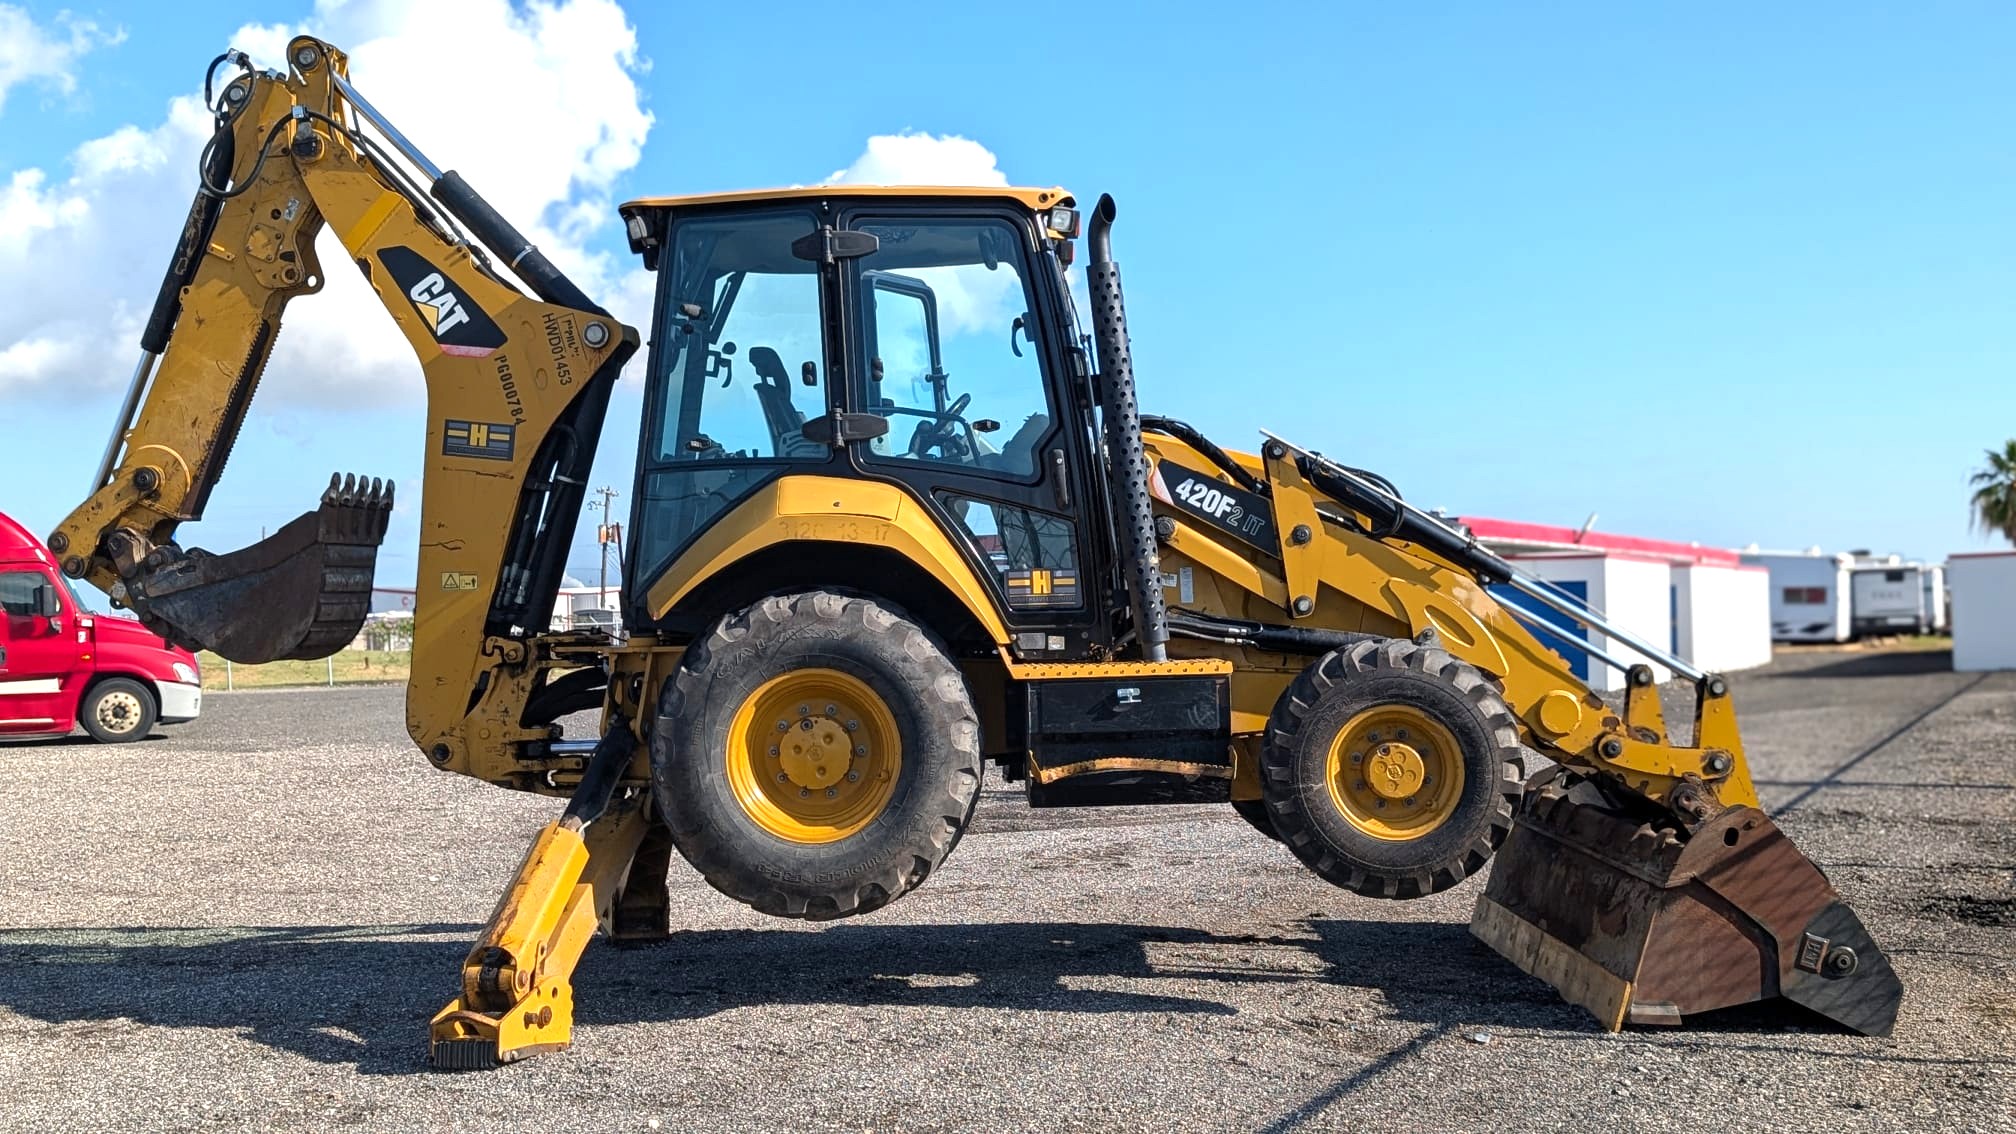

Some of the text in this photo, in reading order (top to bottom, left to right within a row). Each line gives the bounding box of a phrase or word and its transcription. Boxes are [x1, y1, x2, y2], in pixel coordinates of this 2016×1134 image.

[410, 272, 470, 337] CAT
[542, 312, 572, 386] HWD01453
[494, 354, 527, 425] PG000784
[469, 424, 488, 447] H
[1242, 513, 1265, 536] IT
[1032, 570, 1052, 594] H
